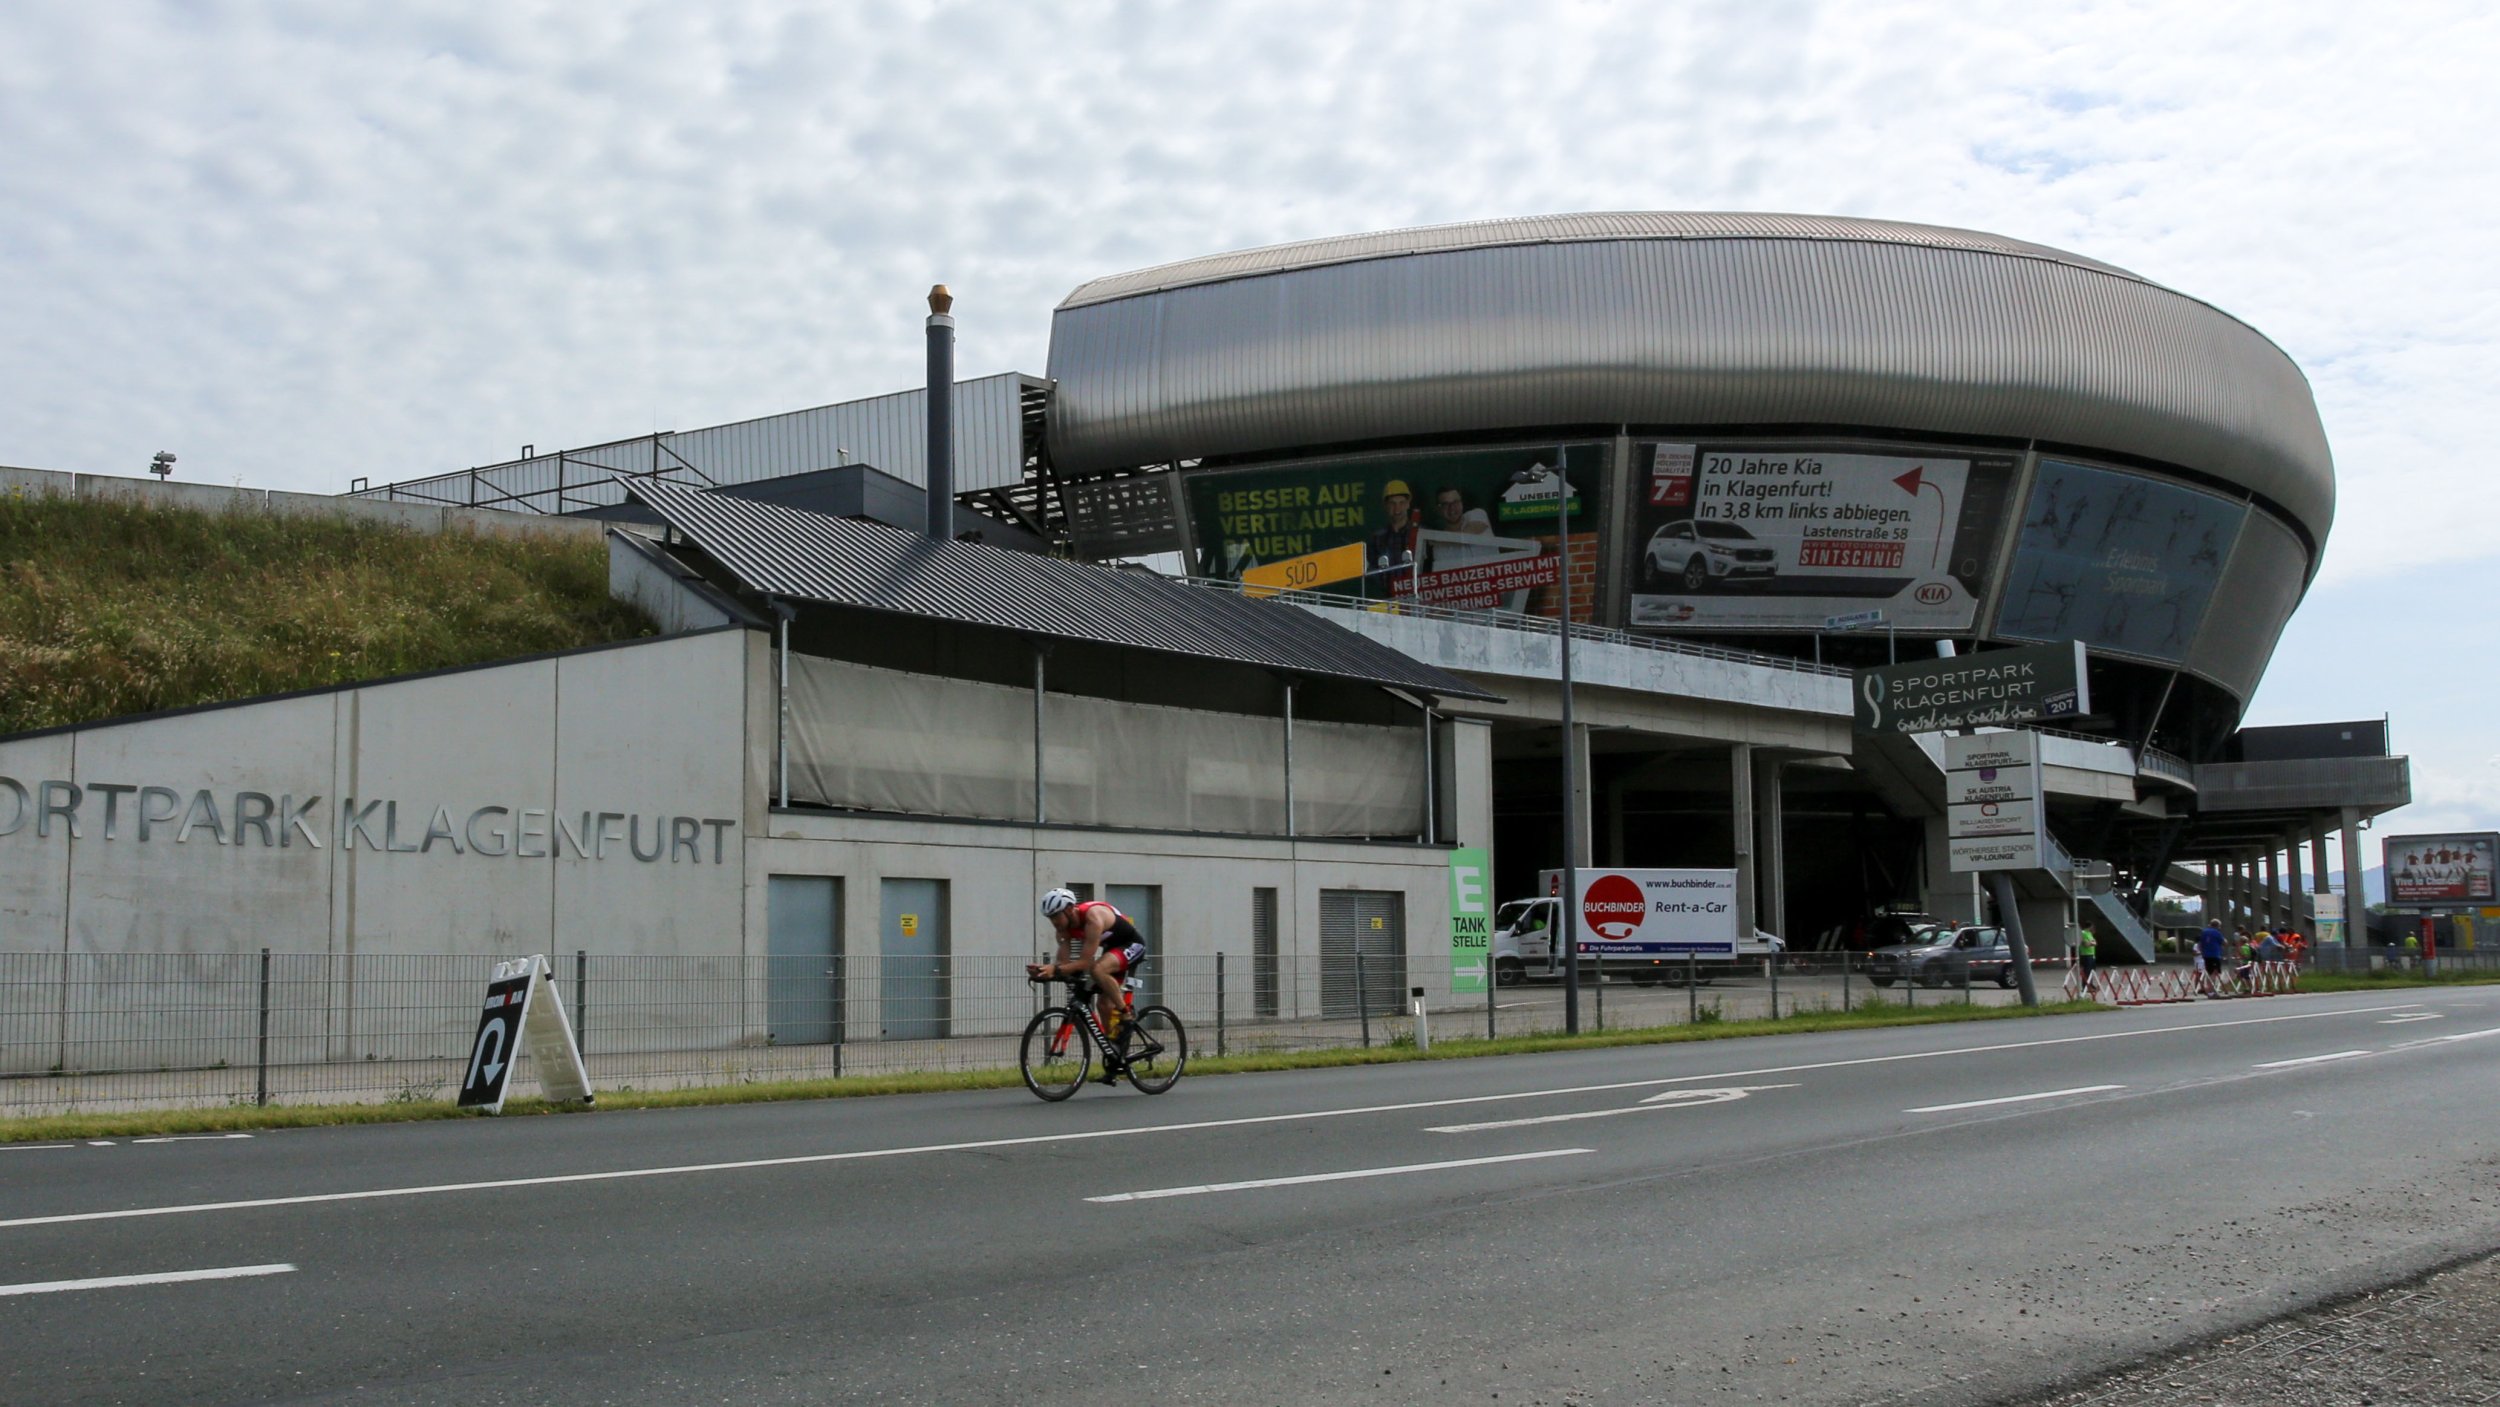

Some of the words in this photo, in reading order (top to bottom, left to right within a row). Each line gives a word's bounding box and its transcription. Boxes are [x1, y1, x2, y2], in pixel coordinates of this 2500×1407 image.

[1707, 458, 1732, 475] 20
[1736, 458, 1788, 475] Jahre
[1793, 458, 1823, 475] Kia
[1218, 486, 1311, 512] BESSER
[1316, 482, 1365, 505] AUF
[1519, 491, 1560, 501] UNSER
[1653, 479, 1673, 501] 7
[1703, 480, 1720, 496] in
[1726, 480, 1833, 500] Klagenfurt!
[1218, 506, 1365, 535] VERTRAUEN
[1699, 501, 1717, 518] In
[1721, 502, 1751, 520] 3,8
[1755, 502, 1784, 519] km
[1788, 502, 1828, 519] links
[1832, 504, 1911, 524] abbiegen.
[1802, 525, 1889, 539] Lastenstraße
[1892, 527, 1909, 540] 58
[1223, 534, 1313, 558] BAUEN!
[1800, 549, 1903, 567] SINTSCHNIG
[1285, 560, 1318, 587] SÜD
[1393, 576, 1438, 592] NEUES
[1440, 560, 1534, 585] BAUZENTRUM
[1538, 555, 1561, 570] MIT
[1920, 588, 1945, 600] KIA
[1838, 613, 1869, 623] AUSGANG
[1892, 663, 2035, 693] SPORTPARK
[1893, 681, 2036, 711] KLAGENFURT
[2050, 699, 2074, 714] 207
[1965, 758, 2013, 767] KLAGENFURT
[1966, 751, 2010, 761] SPORTPARK
[1964, 793, 2016, 802] KLAGENFURT
[1979, 785, 2012, 794] AUSTRIA
[343, 797, 736, 865] KLAGENFURT
[2001, 844, 2034, 853] STADION
[1969, 853, 2016, 862] VIP-LOUNGE
[1454, 866, 1485, 912] E
[1583, 902, 1645, 913] BUCHBINDER
[1655, 901, 1728, 913] Rent-a-Car
[1452, 917, 1487, 933] TANK
[1452, 935, 1487, 948] STELLE
